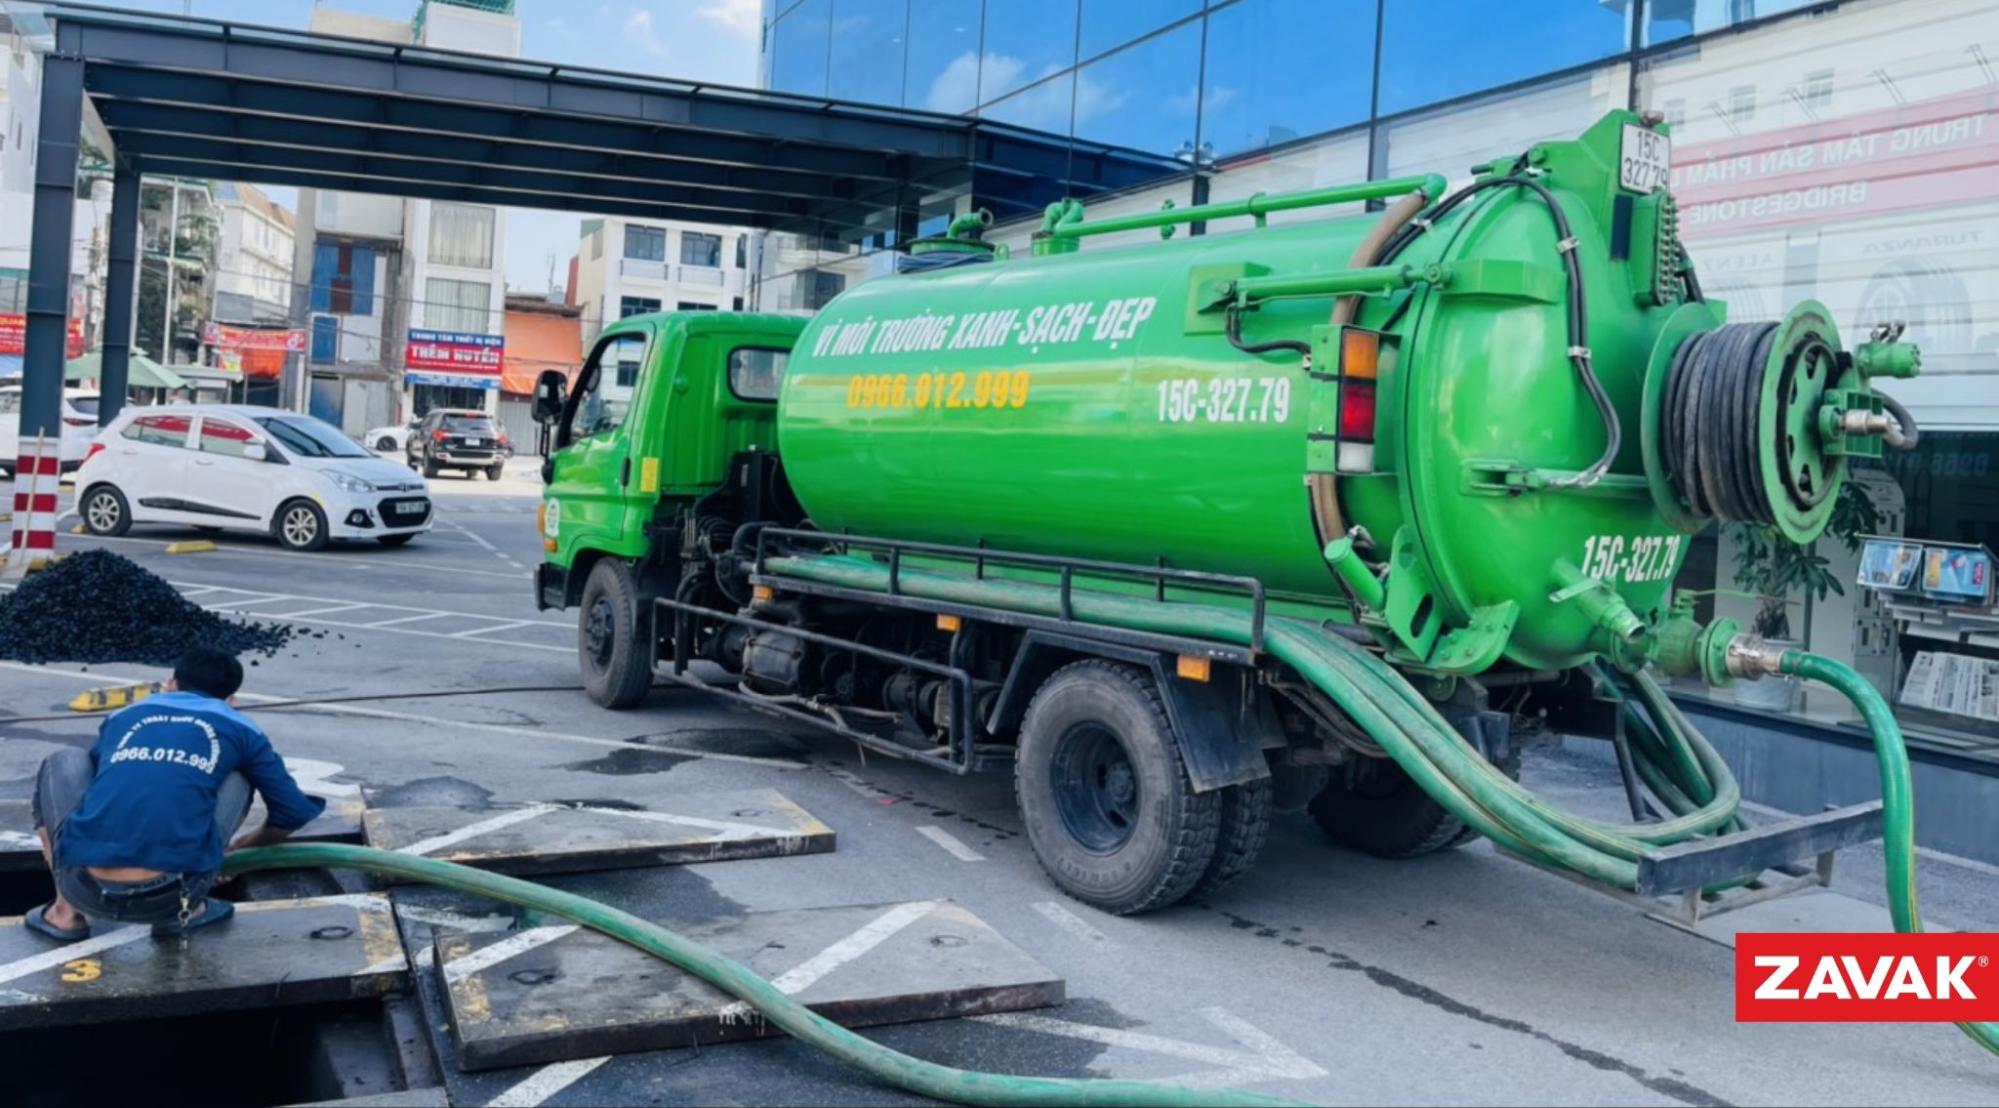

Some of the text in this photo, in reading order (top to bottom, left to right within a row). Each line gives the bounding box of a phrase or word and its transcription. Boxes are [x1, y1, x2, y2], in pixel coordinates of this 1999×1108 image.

[1638, 131, 1660, 162] 15C
[869, 307, 955, 354] TRƯỜNG
[947, 296, 1157, 353] XANH-SẠCH-ĐẸP
[847, 370, 1031, 408] 0966.012.999
[1157, 376, 1291, 423] 15C-327.79
[1581, 534, 1681, 583] 15C-327.79
[110, 746, 216, 774] 0966.012.999
